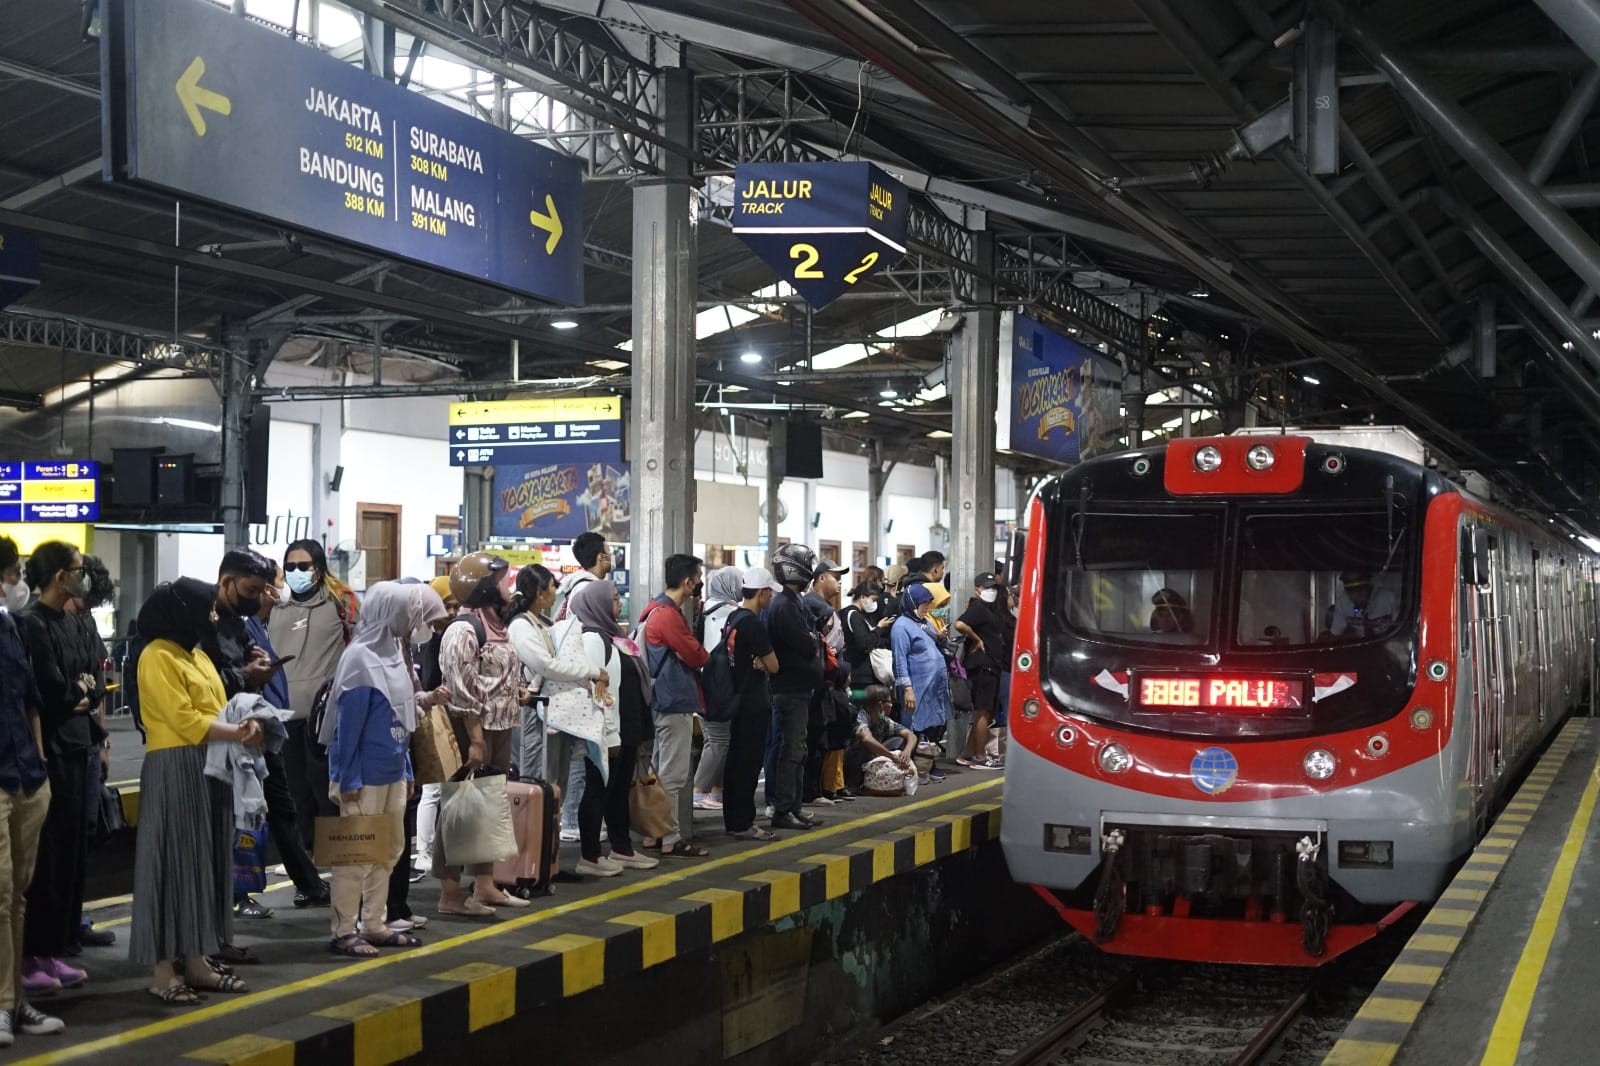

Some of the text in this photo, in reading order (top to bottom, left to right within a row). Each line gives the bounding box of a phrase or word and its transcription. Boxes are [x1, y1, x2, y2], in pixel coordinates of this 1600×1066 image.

[305, 87, 382, 136] JAKARTA
[345, 133, 384, 160] 512 KM
[410, 126, 484, 175] SURABAYA
[300, 148, 384, 198] BANDUNG
[410, 155, 448, 182] 308 KM
[741, 180, 812, 199] JALUR
[869, 182, 893, 211] JALUR
[344, 193, 385, 219] 388 KM
[411, 185, 476, 228] MALANG
[741, 203, 785, 214] TRACK
[411, 212, 447, 237] 391 KM
[789, 243, 825, 279] 2
[843, 252, 879, 284] 2
